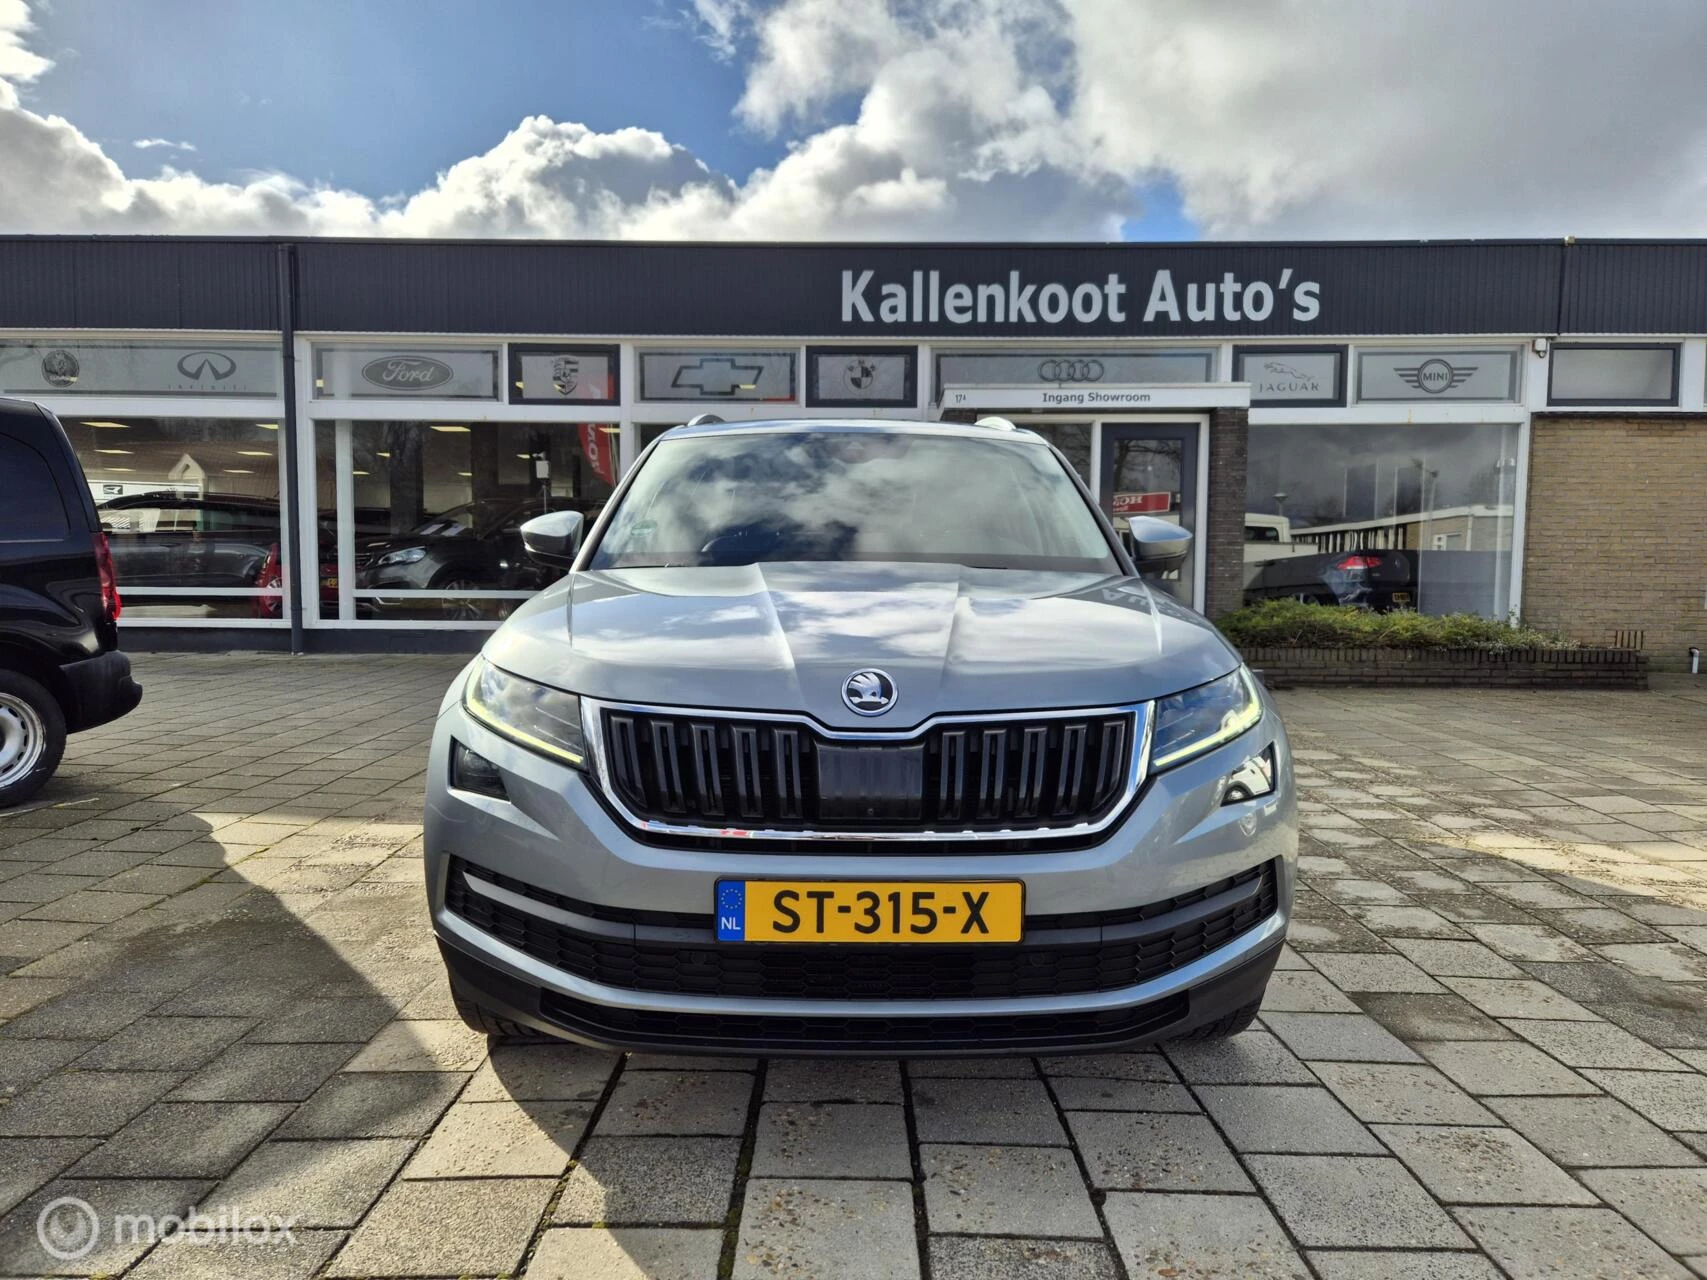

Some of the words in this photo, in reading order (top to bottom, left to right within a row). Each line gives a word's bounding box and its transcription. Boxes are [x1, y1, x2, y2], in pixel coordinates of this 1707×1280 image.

[841, 269, 1126, 324] Kallenkoot
[1143, 267, 1321, 323] Auto's
[382, 360, 435, 382] Ford
[1422, 372, 1449, 382] MINI
[1259, 382, 1320, 393] JAGUAR
[1042, 392, 1085, 405] Ingang
[1087, 391, 1151, 403] Showroom
[720, 916, 741, 930] NL
[772, 889, 990, 934] ST-315-X
